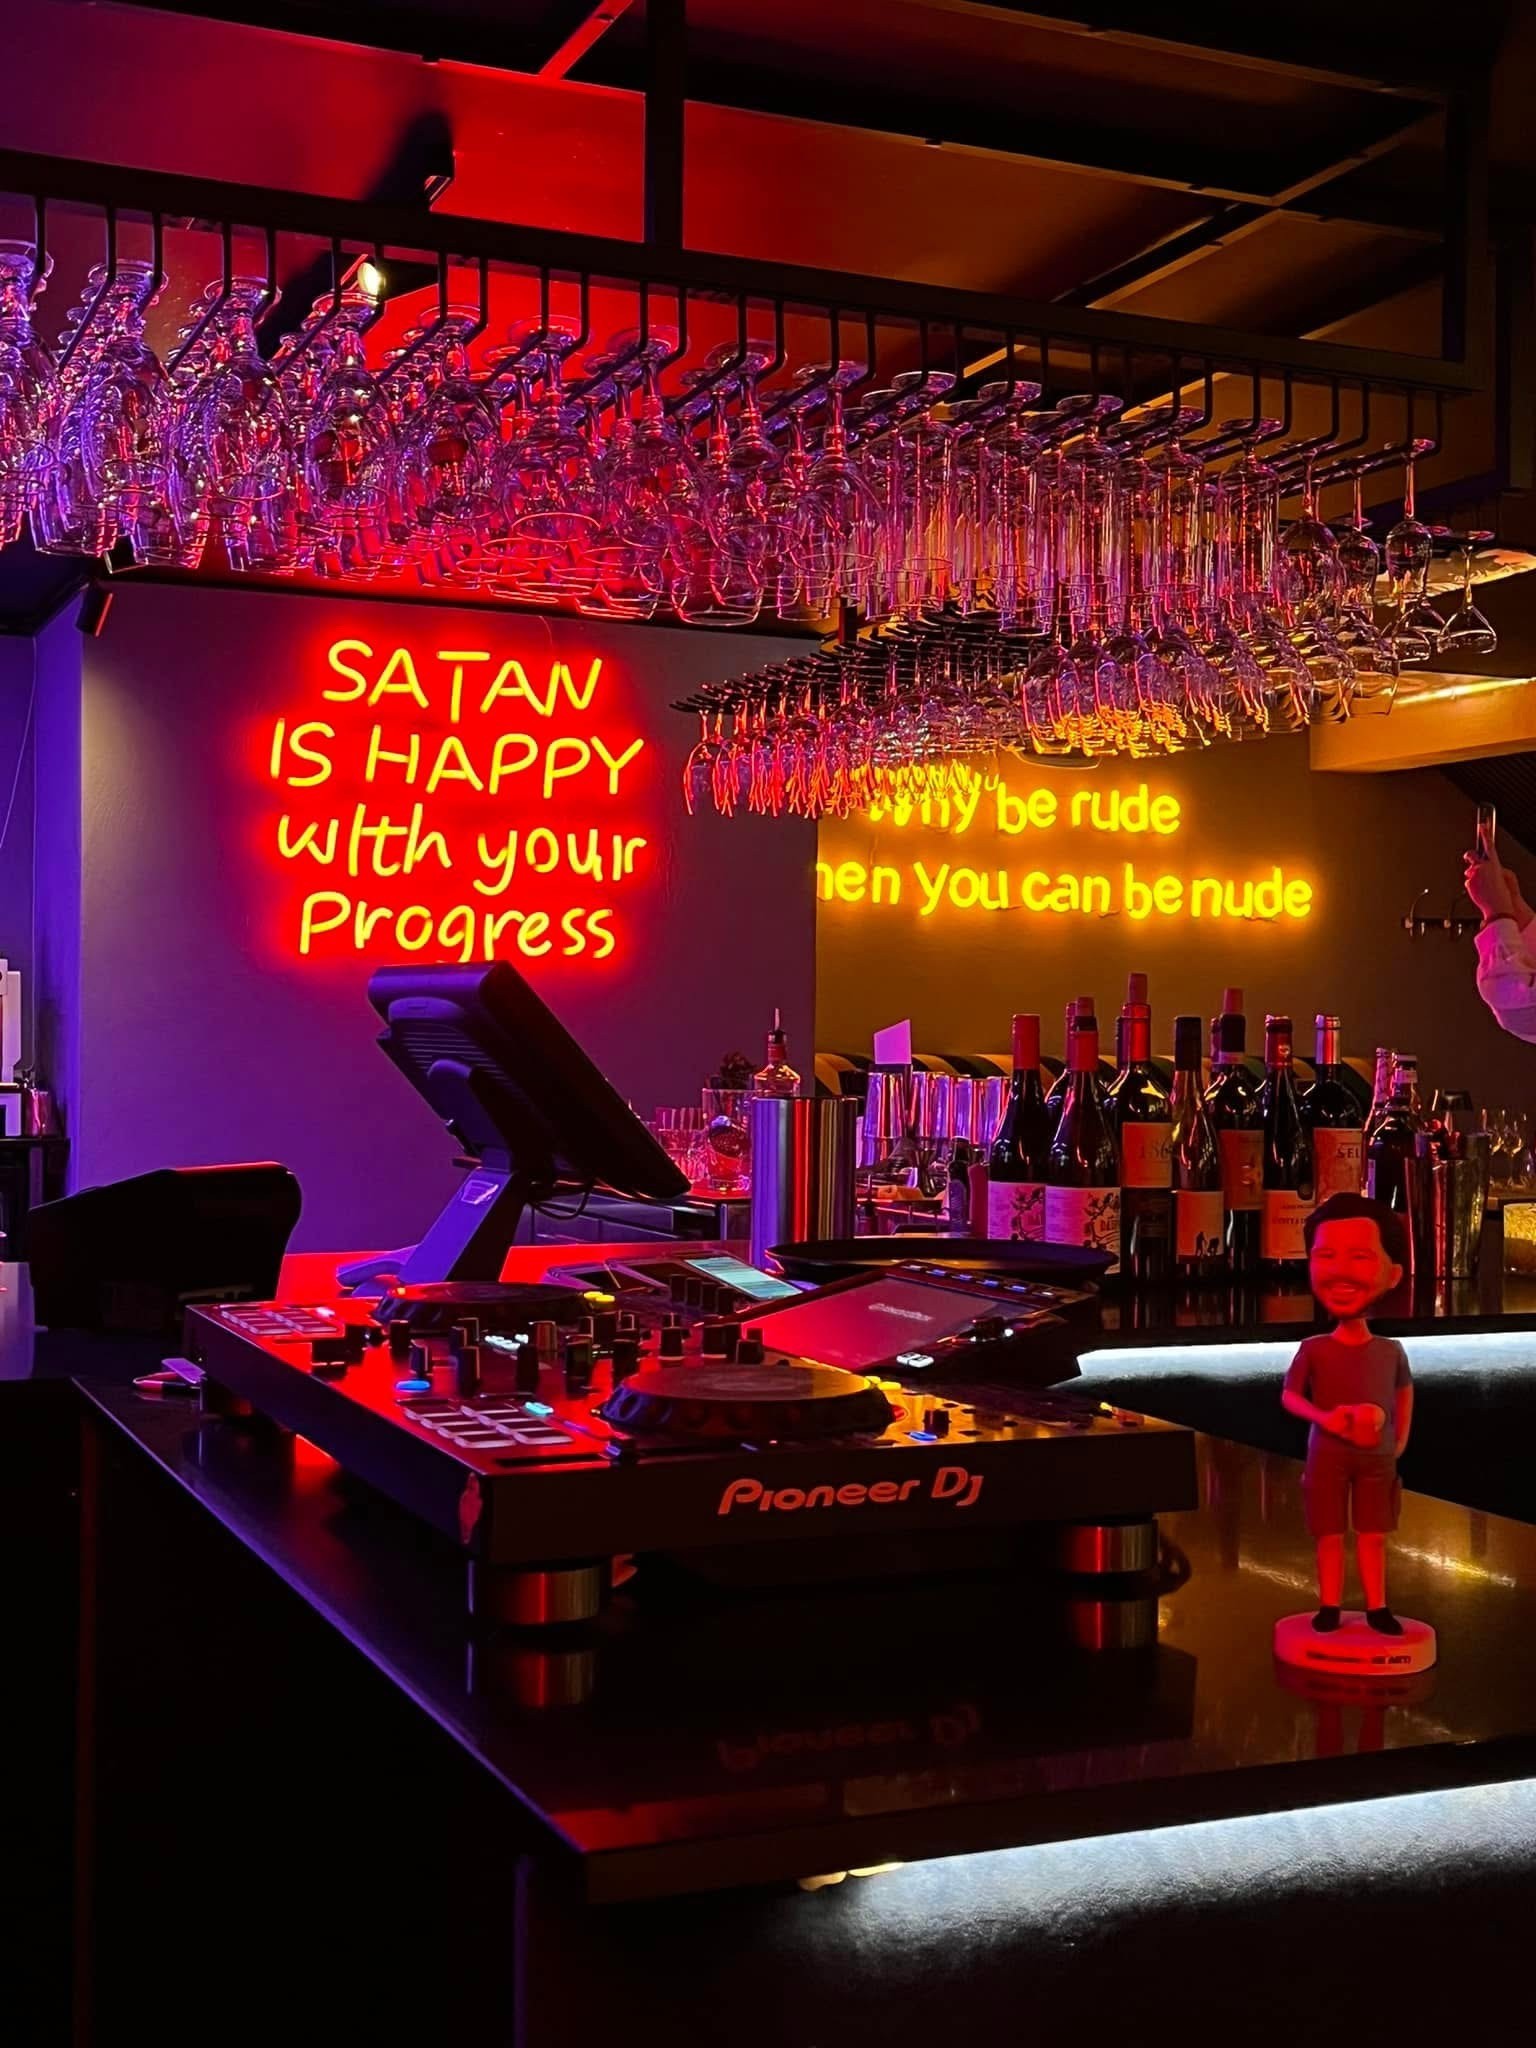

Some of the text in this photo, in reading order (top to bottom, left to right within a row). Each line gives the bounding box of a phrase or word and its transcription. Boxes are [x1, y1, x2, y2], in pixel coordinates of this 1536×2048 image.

[322, 639, 602, 723] SATAN
[270, 718, 644, 799] IS HAPPY
[998, 783, 1058, 834] be
[1071, 783, 1181, 834] rude
[473, 828, 647, 896] your
[913, 861, 1008, 915] you
[1020, 870, 1111, 914] can
[1124, 862, 1184, 920] be
[1190, 866, 1313, 918] nude
[718, 1478, 920, 1514] Pioneer
